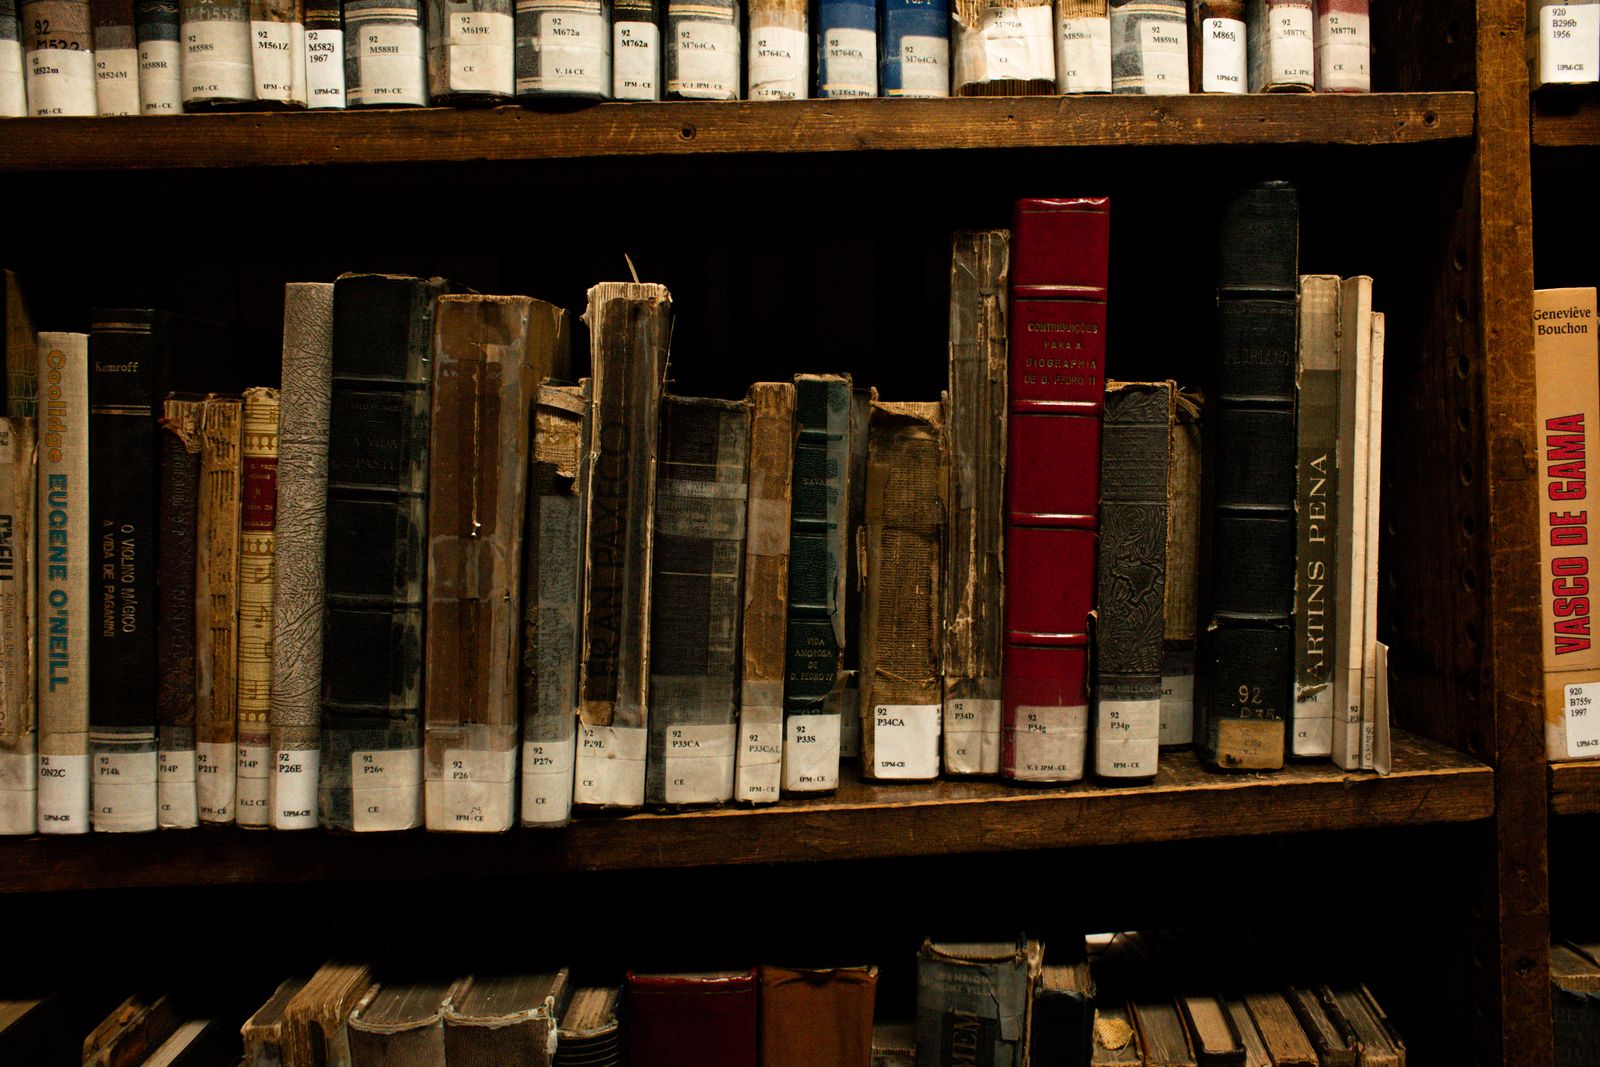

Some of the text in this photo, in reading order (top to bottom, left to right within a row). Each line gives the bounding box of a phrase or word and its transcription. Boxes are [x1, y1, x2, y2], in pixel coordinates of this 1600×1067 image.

[1552, 8, 1566, 16] 920
[35, 20, 49, 35] 92
[1552, 19, 1576, 27] B296b
[309, 32, 318, 40] 92
[553, 28, 580, 36] M672a
[1213, 31, 1236, 41] M865j
[189, 44, 213, 52] M558S
[259, 42, 288, 50] M561Z
[309, 43, 334, 52] M582j
[682, 42, 715, 50] M764CA
[759, 50, 791, 58] M764CA
[310, 55, 328, 63] 1967
[1534, 306, 1591, 320] Geneviève
[1538, 322, 1588, 335] Bouchon
[1044, 341, 1072, 350] PARA
[1025, 358, 1097, 369] BIOGRAPHIA
[1024, 375, 1096, 386] DE D. PEDRO II
[1309, 454, 1330, 542] PENA
[48, 474, 68, 581] EUGENE
[124, 524, 134, 534] O
[1546, 413, 1591, 655] VASCO DE GAMA
[102, 533, 115, 559] VIDA
[120, 539, 134, 583] VIOLINO
[102, 563, 115, 580] DE
[102, 585, 116, 637] PAGANINI
[48, 590, 69, 693] O'NEILL
[806, 637, 825, 646] VIDA
[794, 649, 833, 658] AMOROSA
[808, 661, 818, 669] DE
[801, 673, 825, 681] PEDRO
[1238, 685, 1263, 704] 92
[1570, 697, 1592, 706] B755v
[1571, 708, 1587, 717] 1997
[878, 718, 904, 726] P34CA
[1111, 722, 1129, 731] P34p
[1028, 724, 1046, 734] P34g
[1577, 739, 1599, 747] UPM-CE
[41, 757, 49, 765] 92
[239, 760, 258, 768] P14P
[280, 765, 302, 773] P26E
